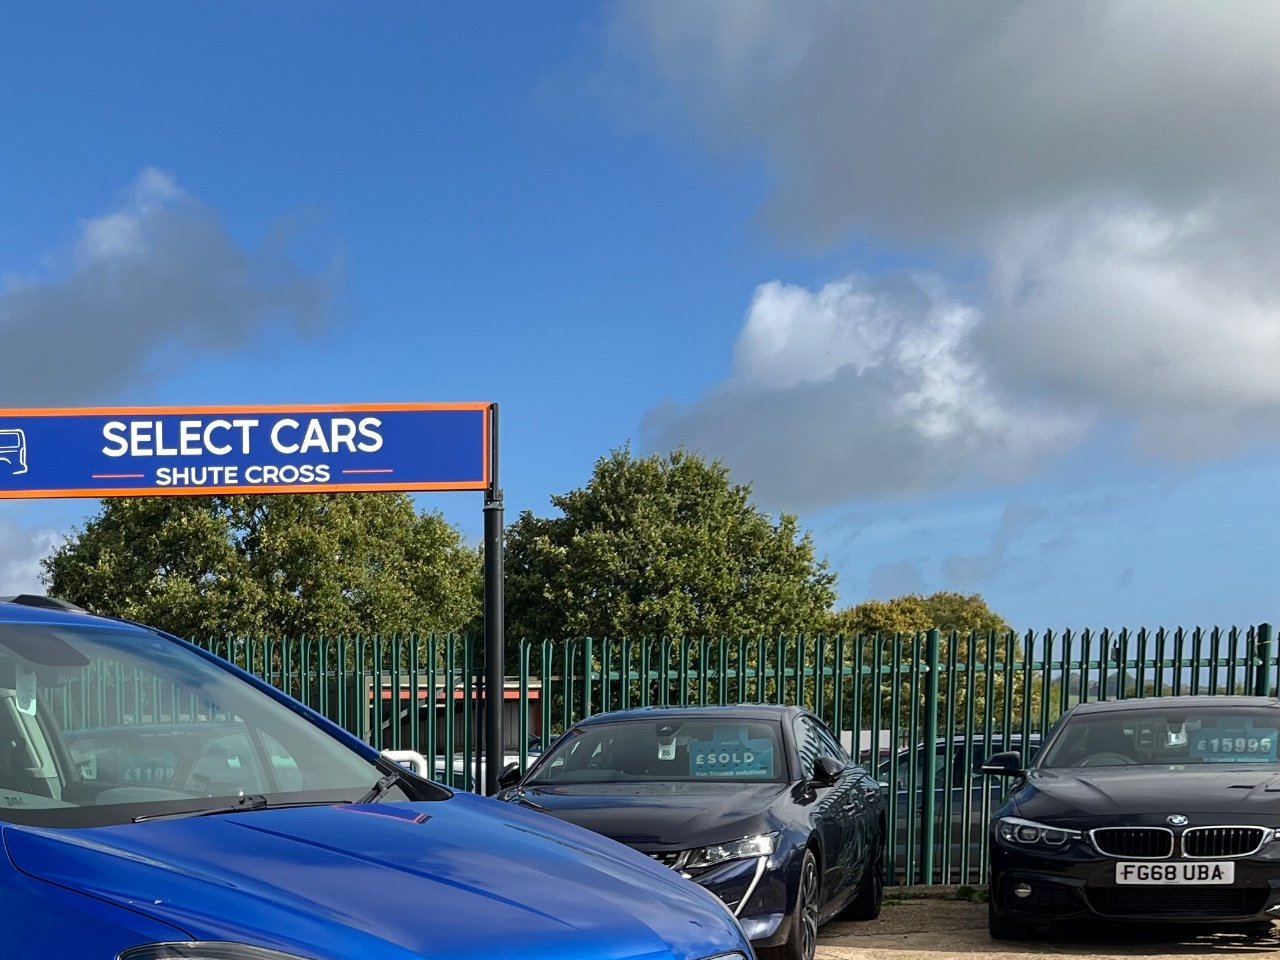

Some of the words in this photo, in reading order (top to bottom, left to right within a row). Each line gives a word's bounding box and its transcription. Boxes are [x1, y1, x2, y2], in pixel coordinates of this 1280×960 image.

[102, 419, 259, 457] SELECT
[270, 417, 383, 454] CARS
[155, 466, 239, 486] SHUTE
[244, 464, 331, 484] CROSS
[1123, 864, 1177, 881] FG68
[1183, 864, 1222, 881] UBA
